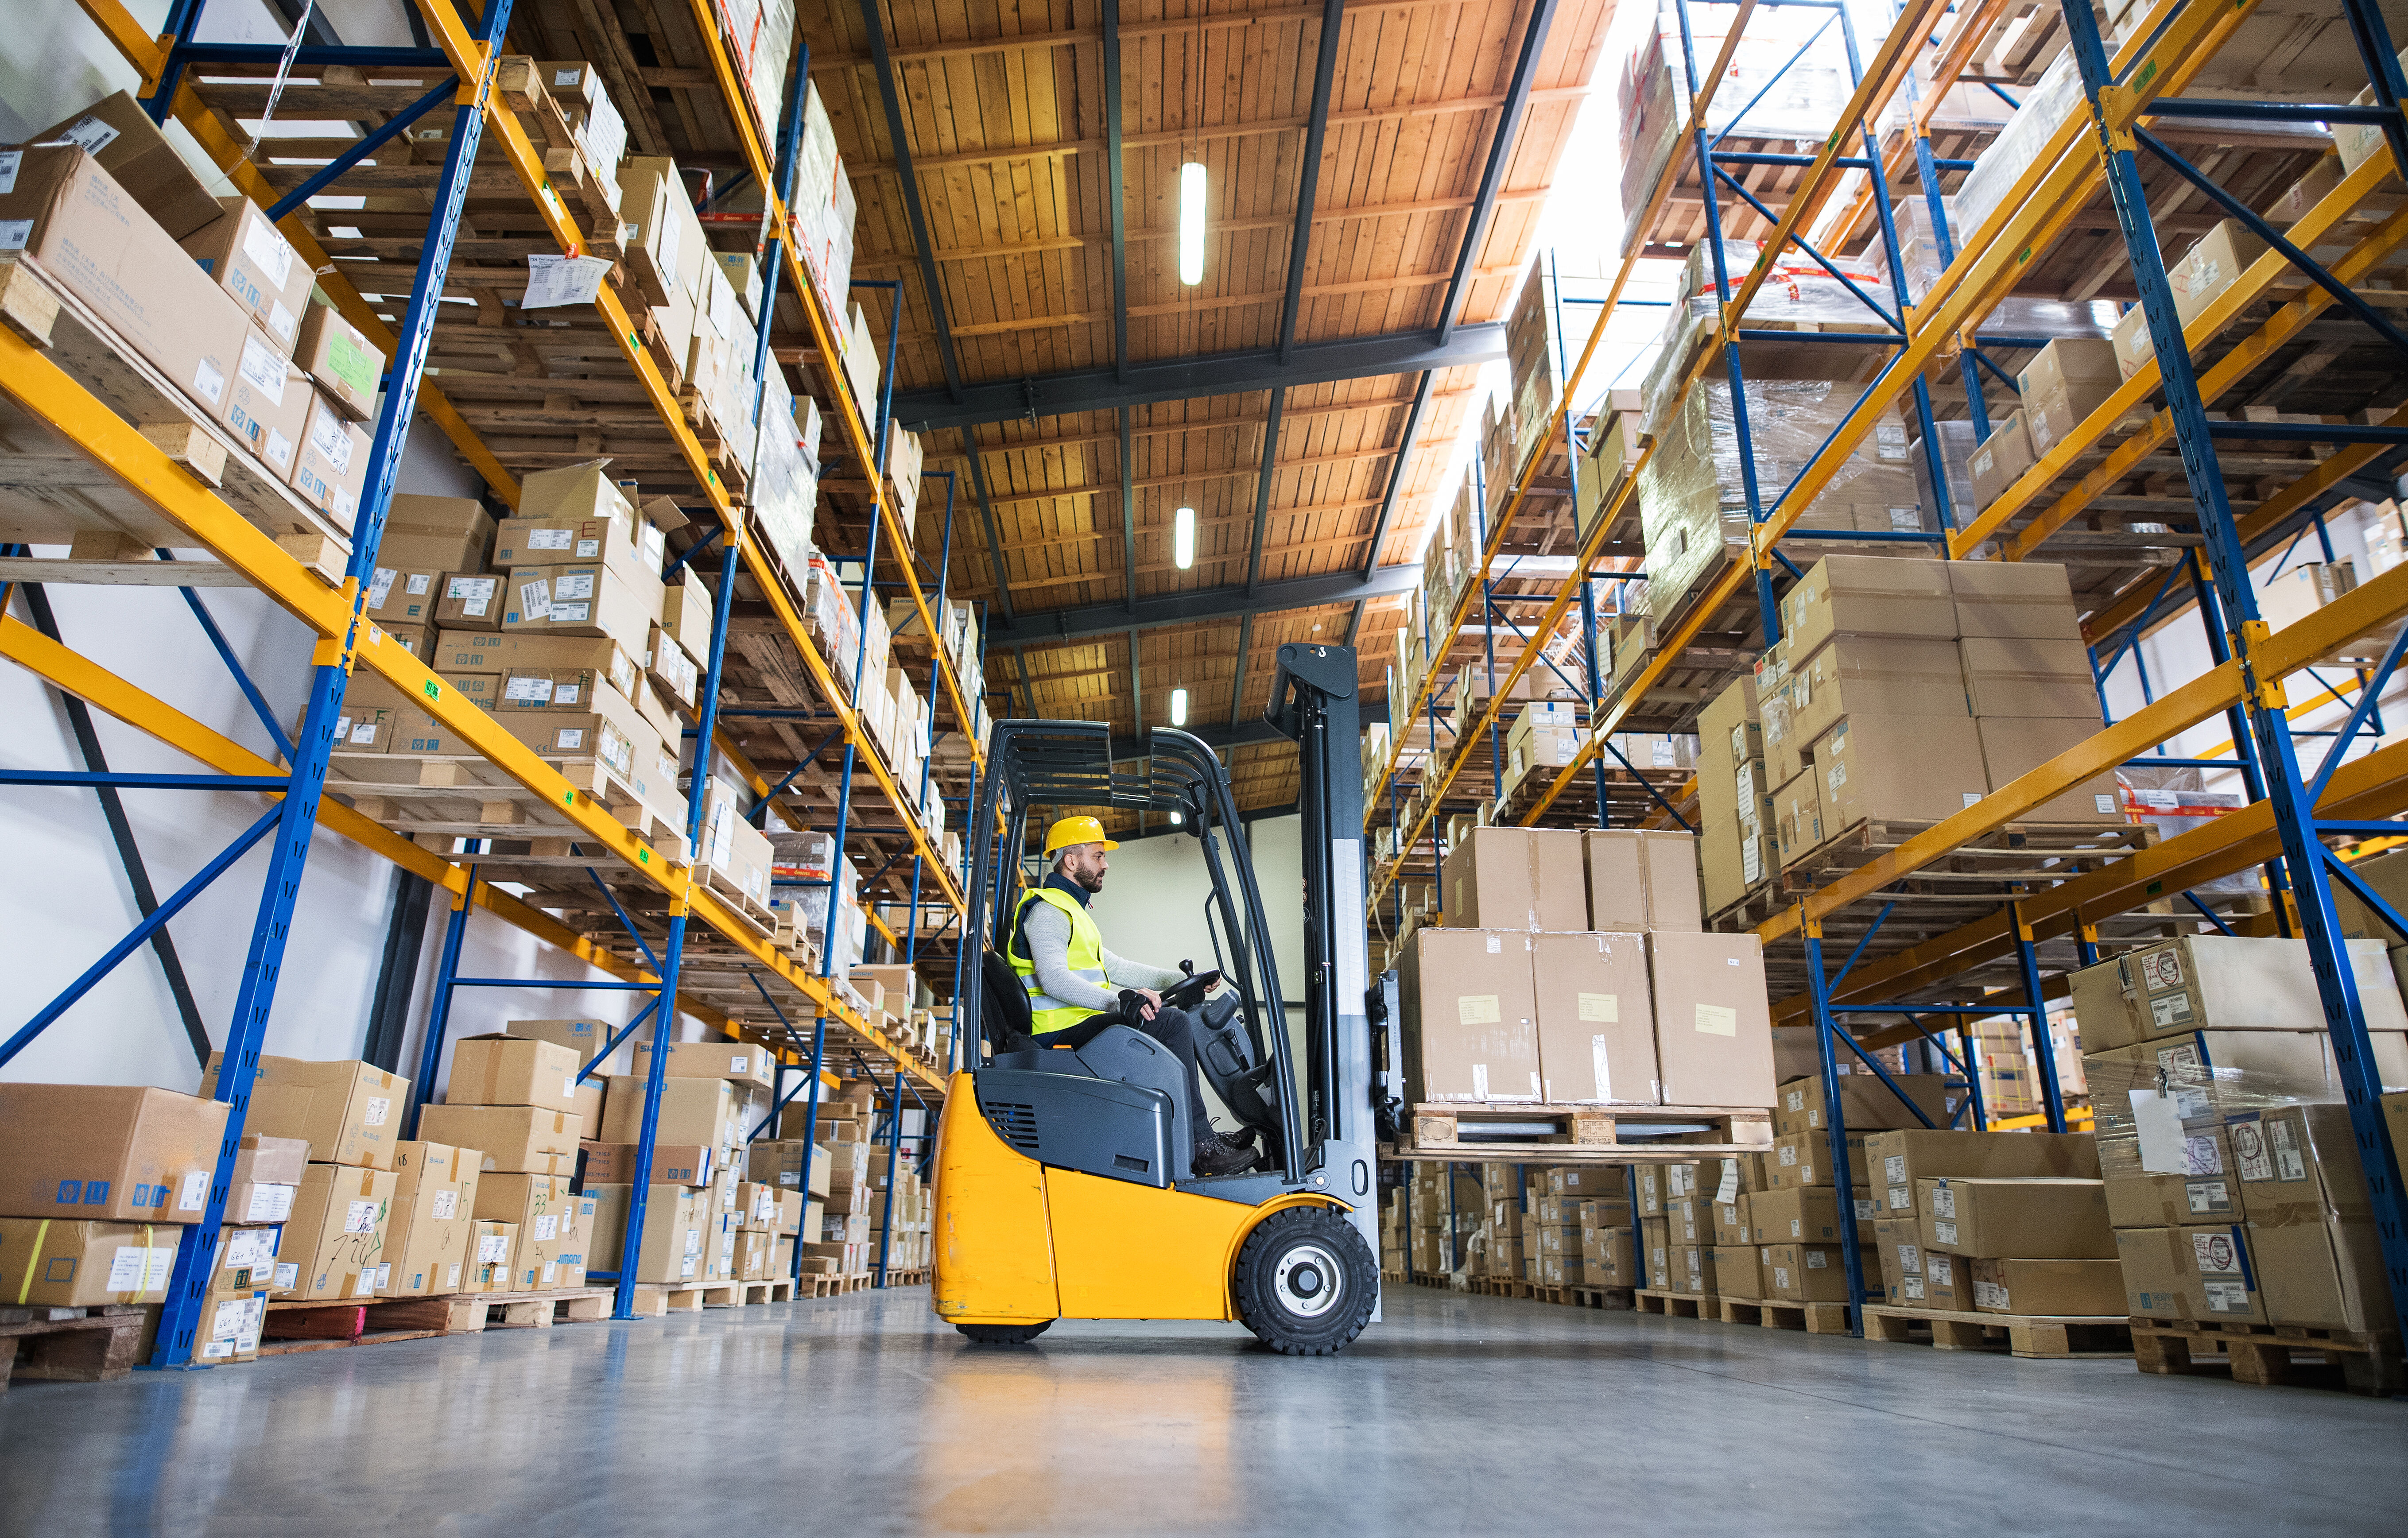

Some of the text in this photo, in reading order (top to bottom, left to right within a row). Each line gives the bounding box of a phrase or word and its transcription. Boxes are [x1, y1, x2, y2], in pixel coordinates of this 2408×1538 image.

[582, 521, 597, 537] E
[398, 1154, 407, 1166] 18
[230, 1251, 244, 1260] 561
[218, 1318, 231, 1329] 561
